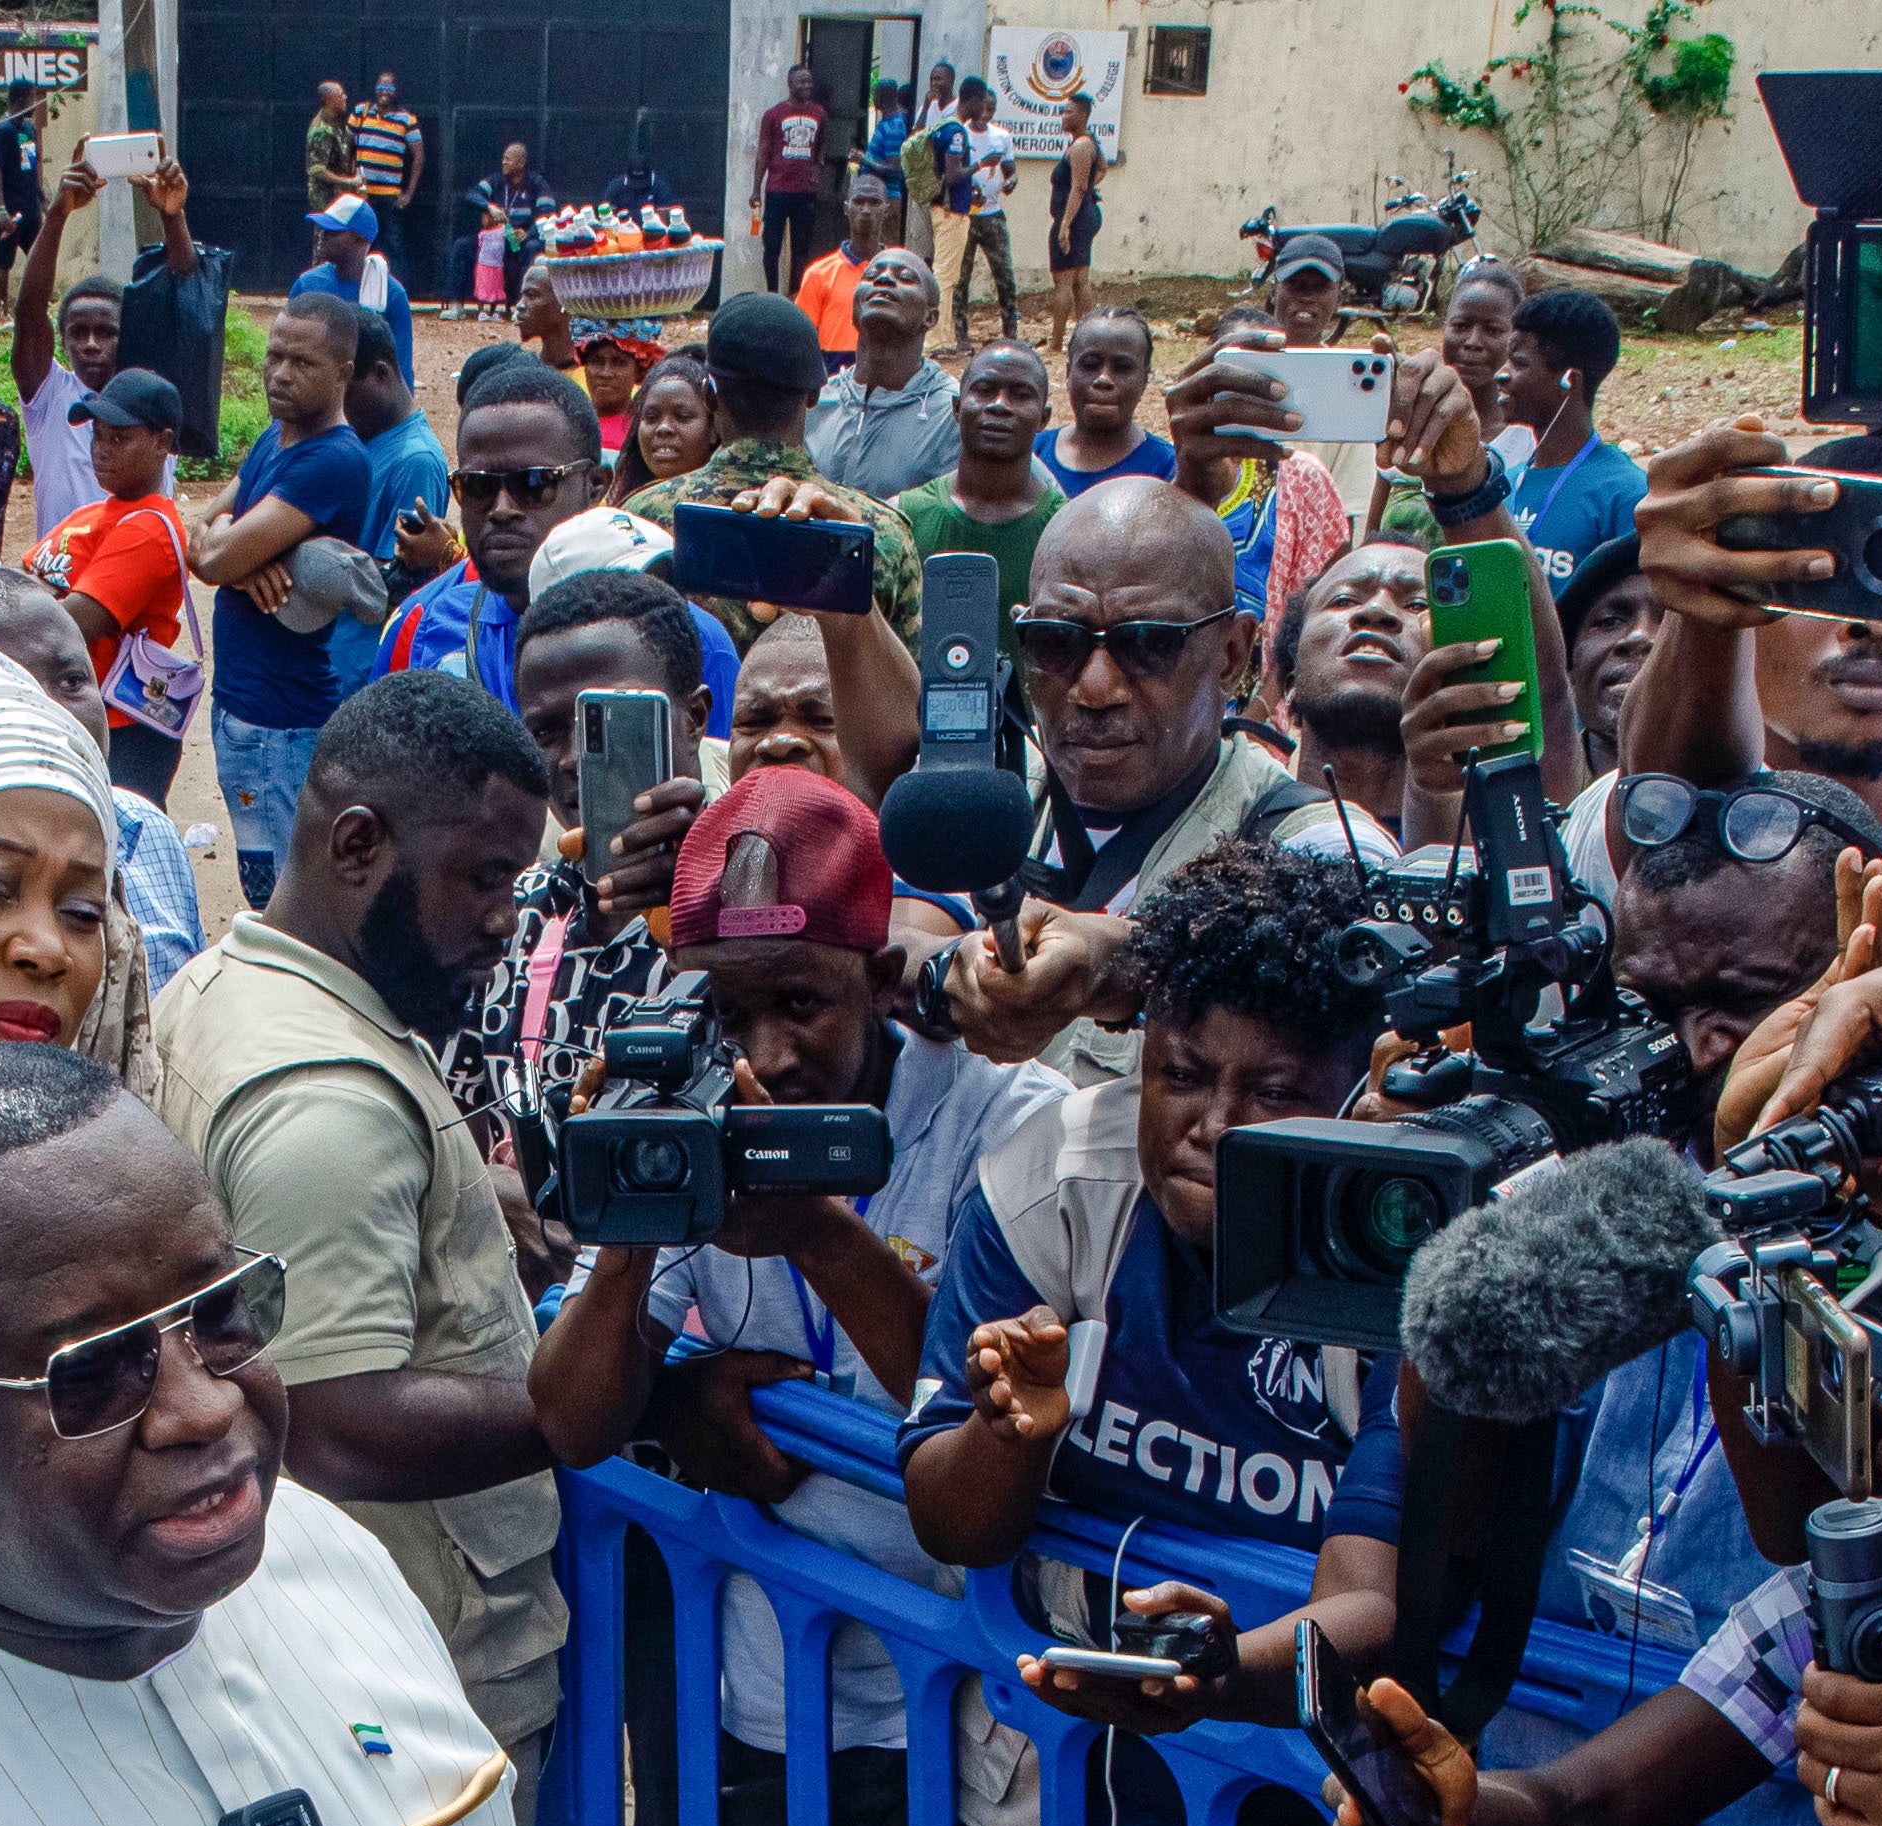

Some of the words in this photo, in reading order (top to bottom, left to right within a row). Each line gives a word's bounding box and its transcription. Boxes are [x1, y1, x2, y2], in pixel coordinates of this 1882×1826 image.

[996, 54, 1012, 95] HORTON
[1007, 91, 1052, 116] COMMAND
[1095, 60, 1121, 103] COLLEGE
[1012, 138, 1064, 152] MEROON
[1512, 793, 1528, 842] SONY
[626, 1044, 663, 1055] Canon
[1647, 1032, 1678, 1055] SONY
[822, 1114, 850, 1123] XF400
[744, 1148, 790, 1161] Canon
